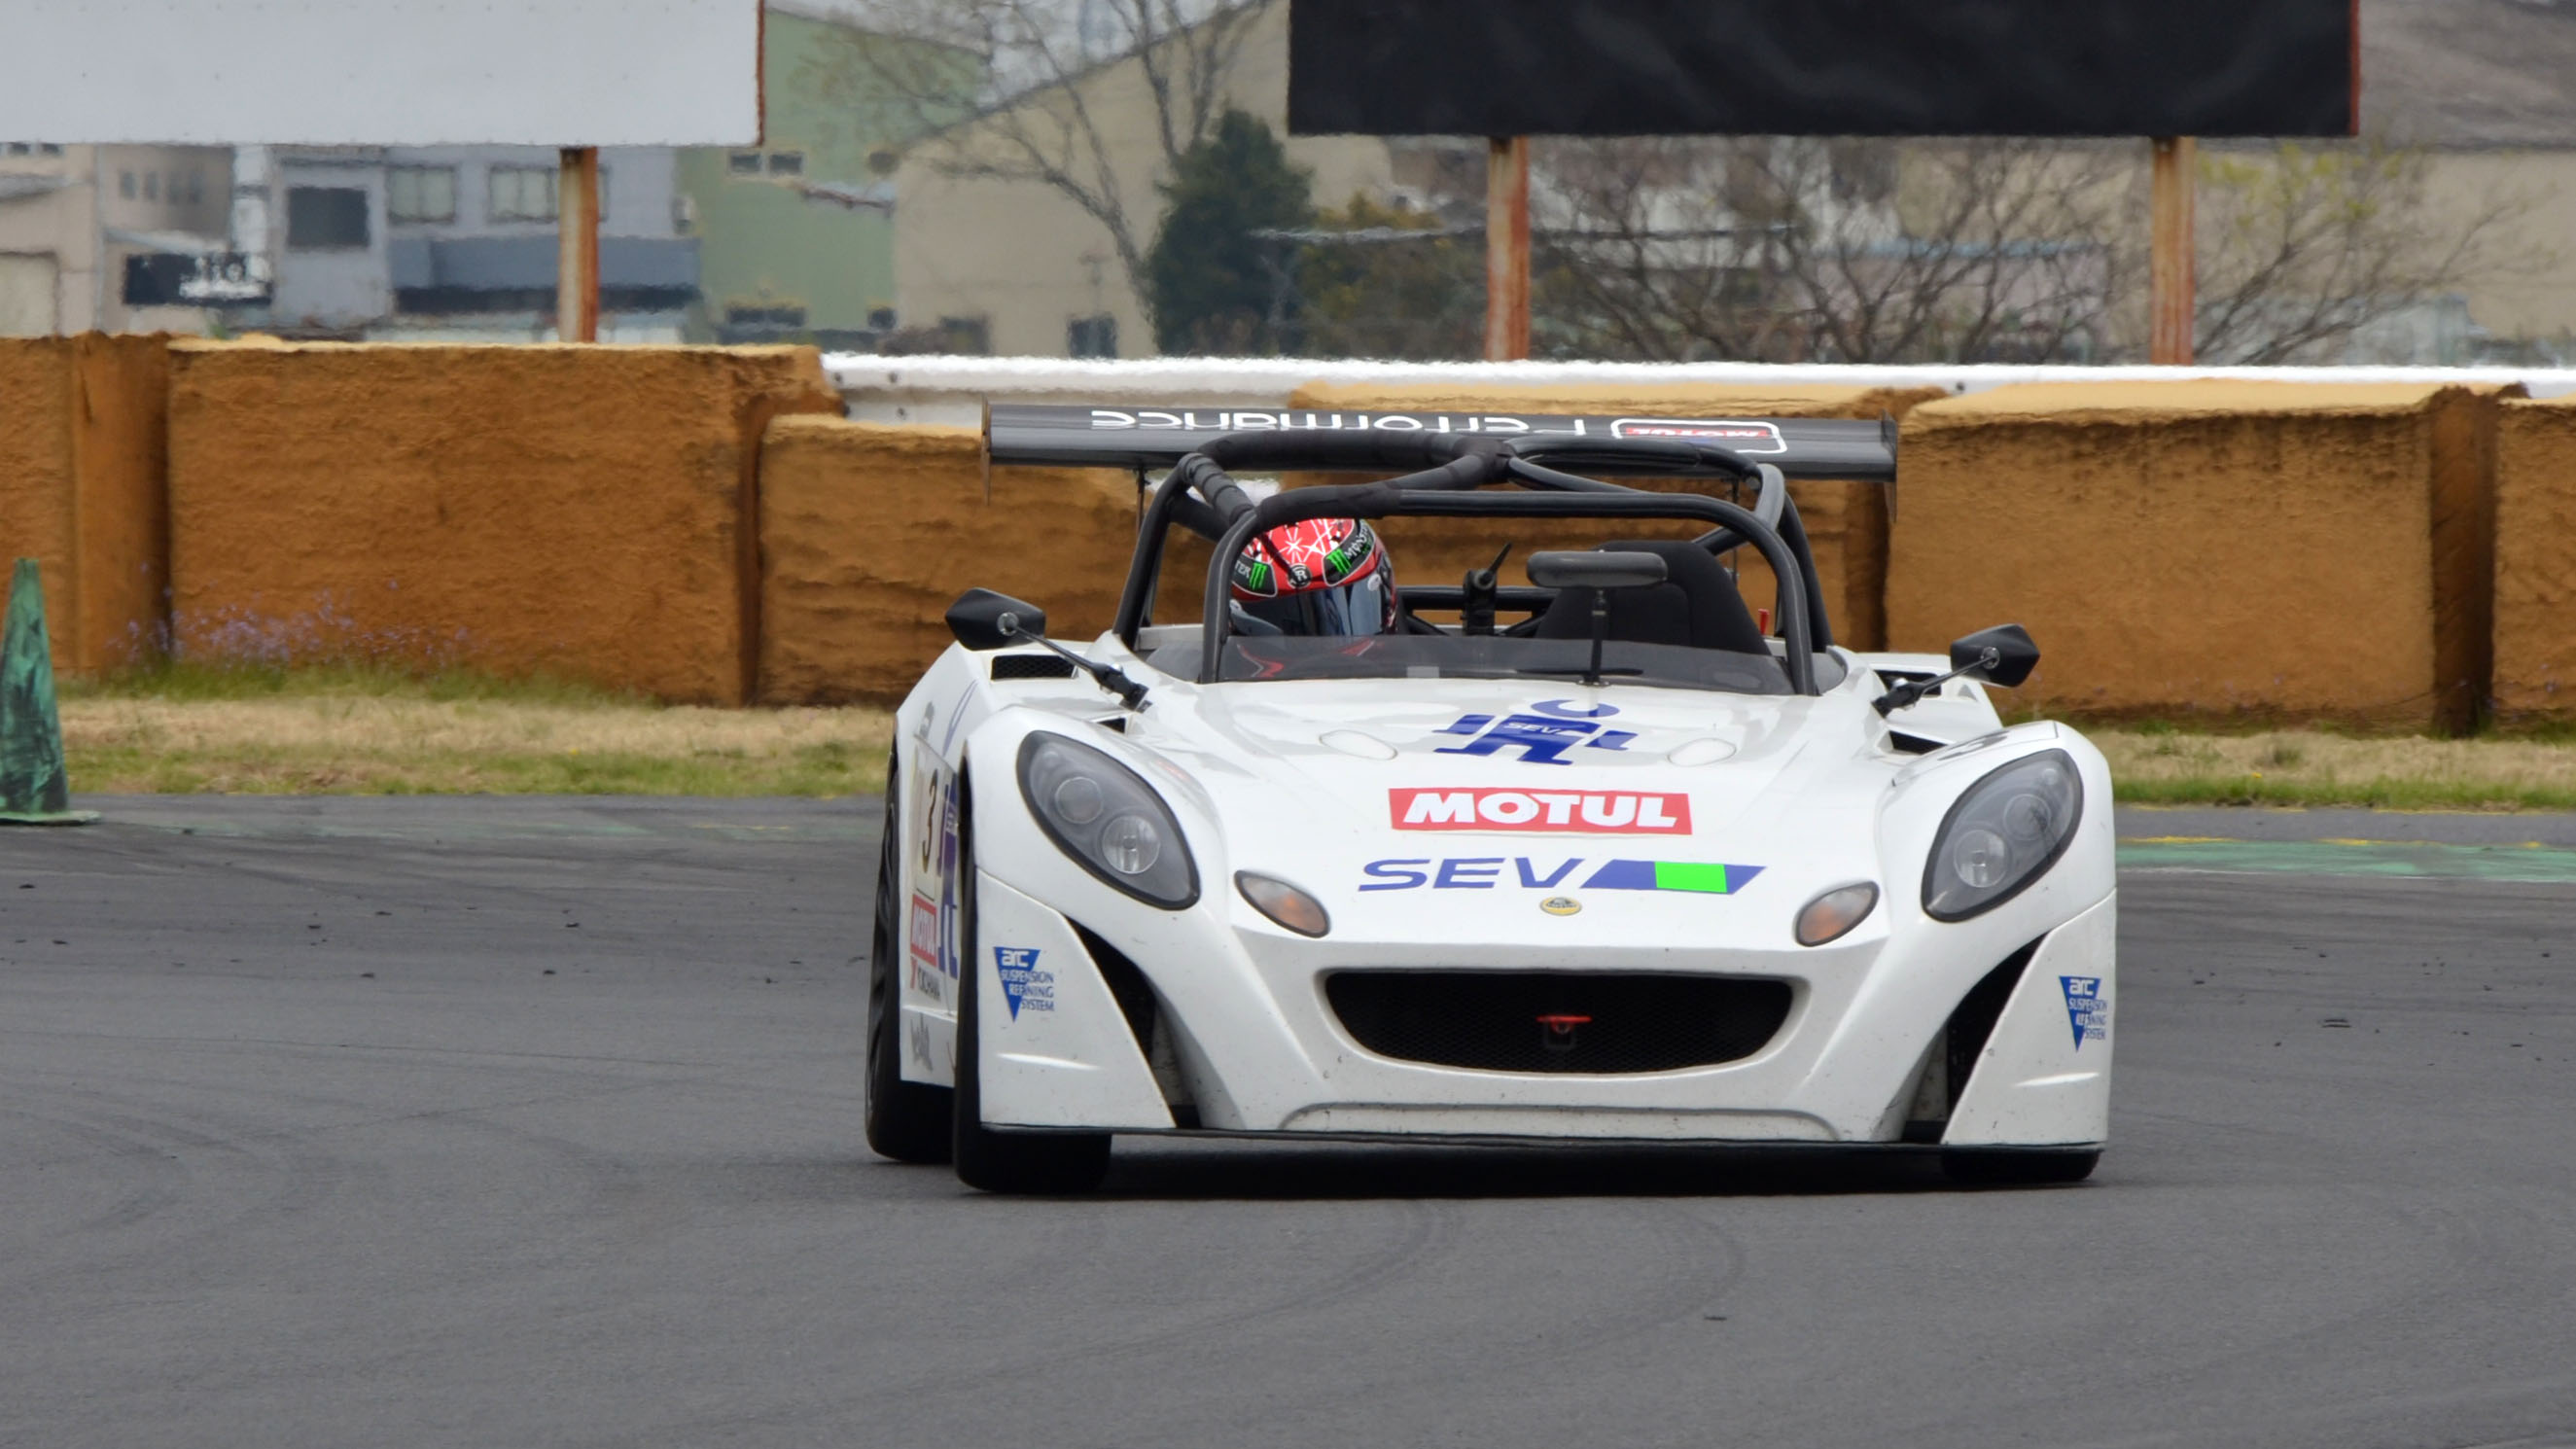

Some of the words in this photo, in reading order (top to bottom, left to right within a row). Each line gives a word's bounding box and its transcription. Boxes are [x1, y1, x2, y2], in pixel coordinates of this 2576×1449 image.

[1402, 793, 1677, 828] MOTUL
[1359, 857, 1585, 892] SEV
[1002, 949, 1030, 968] arc
[1000, 969, 1054, 984] SUSPENSION
[2069, 978, 2095, 996] arc
[1021, 999, 1054, 1012] SYSTEM
